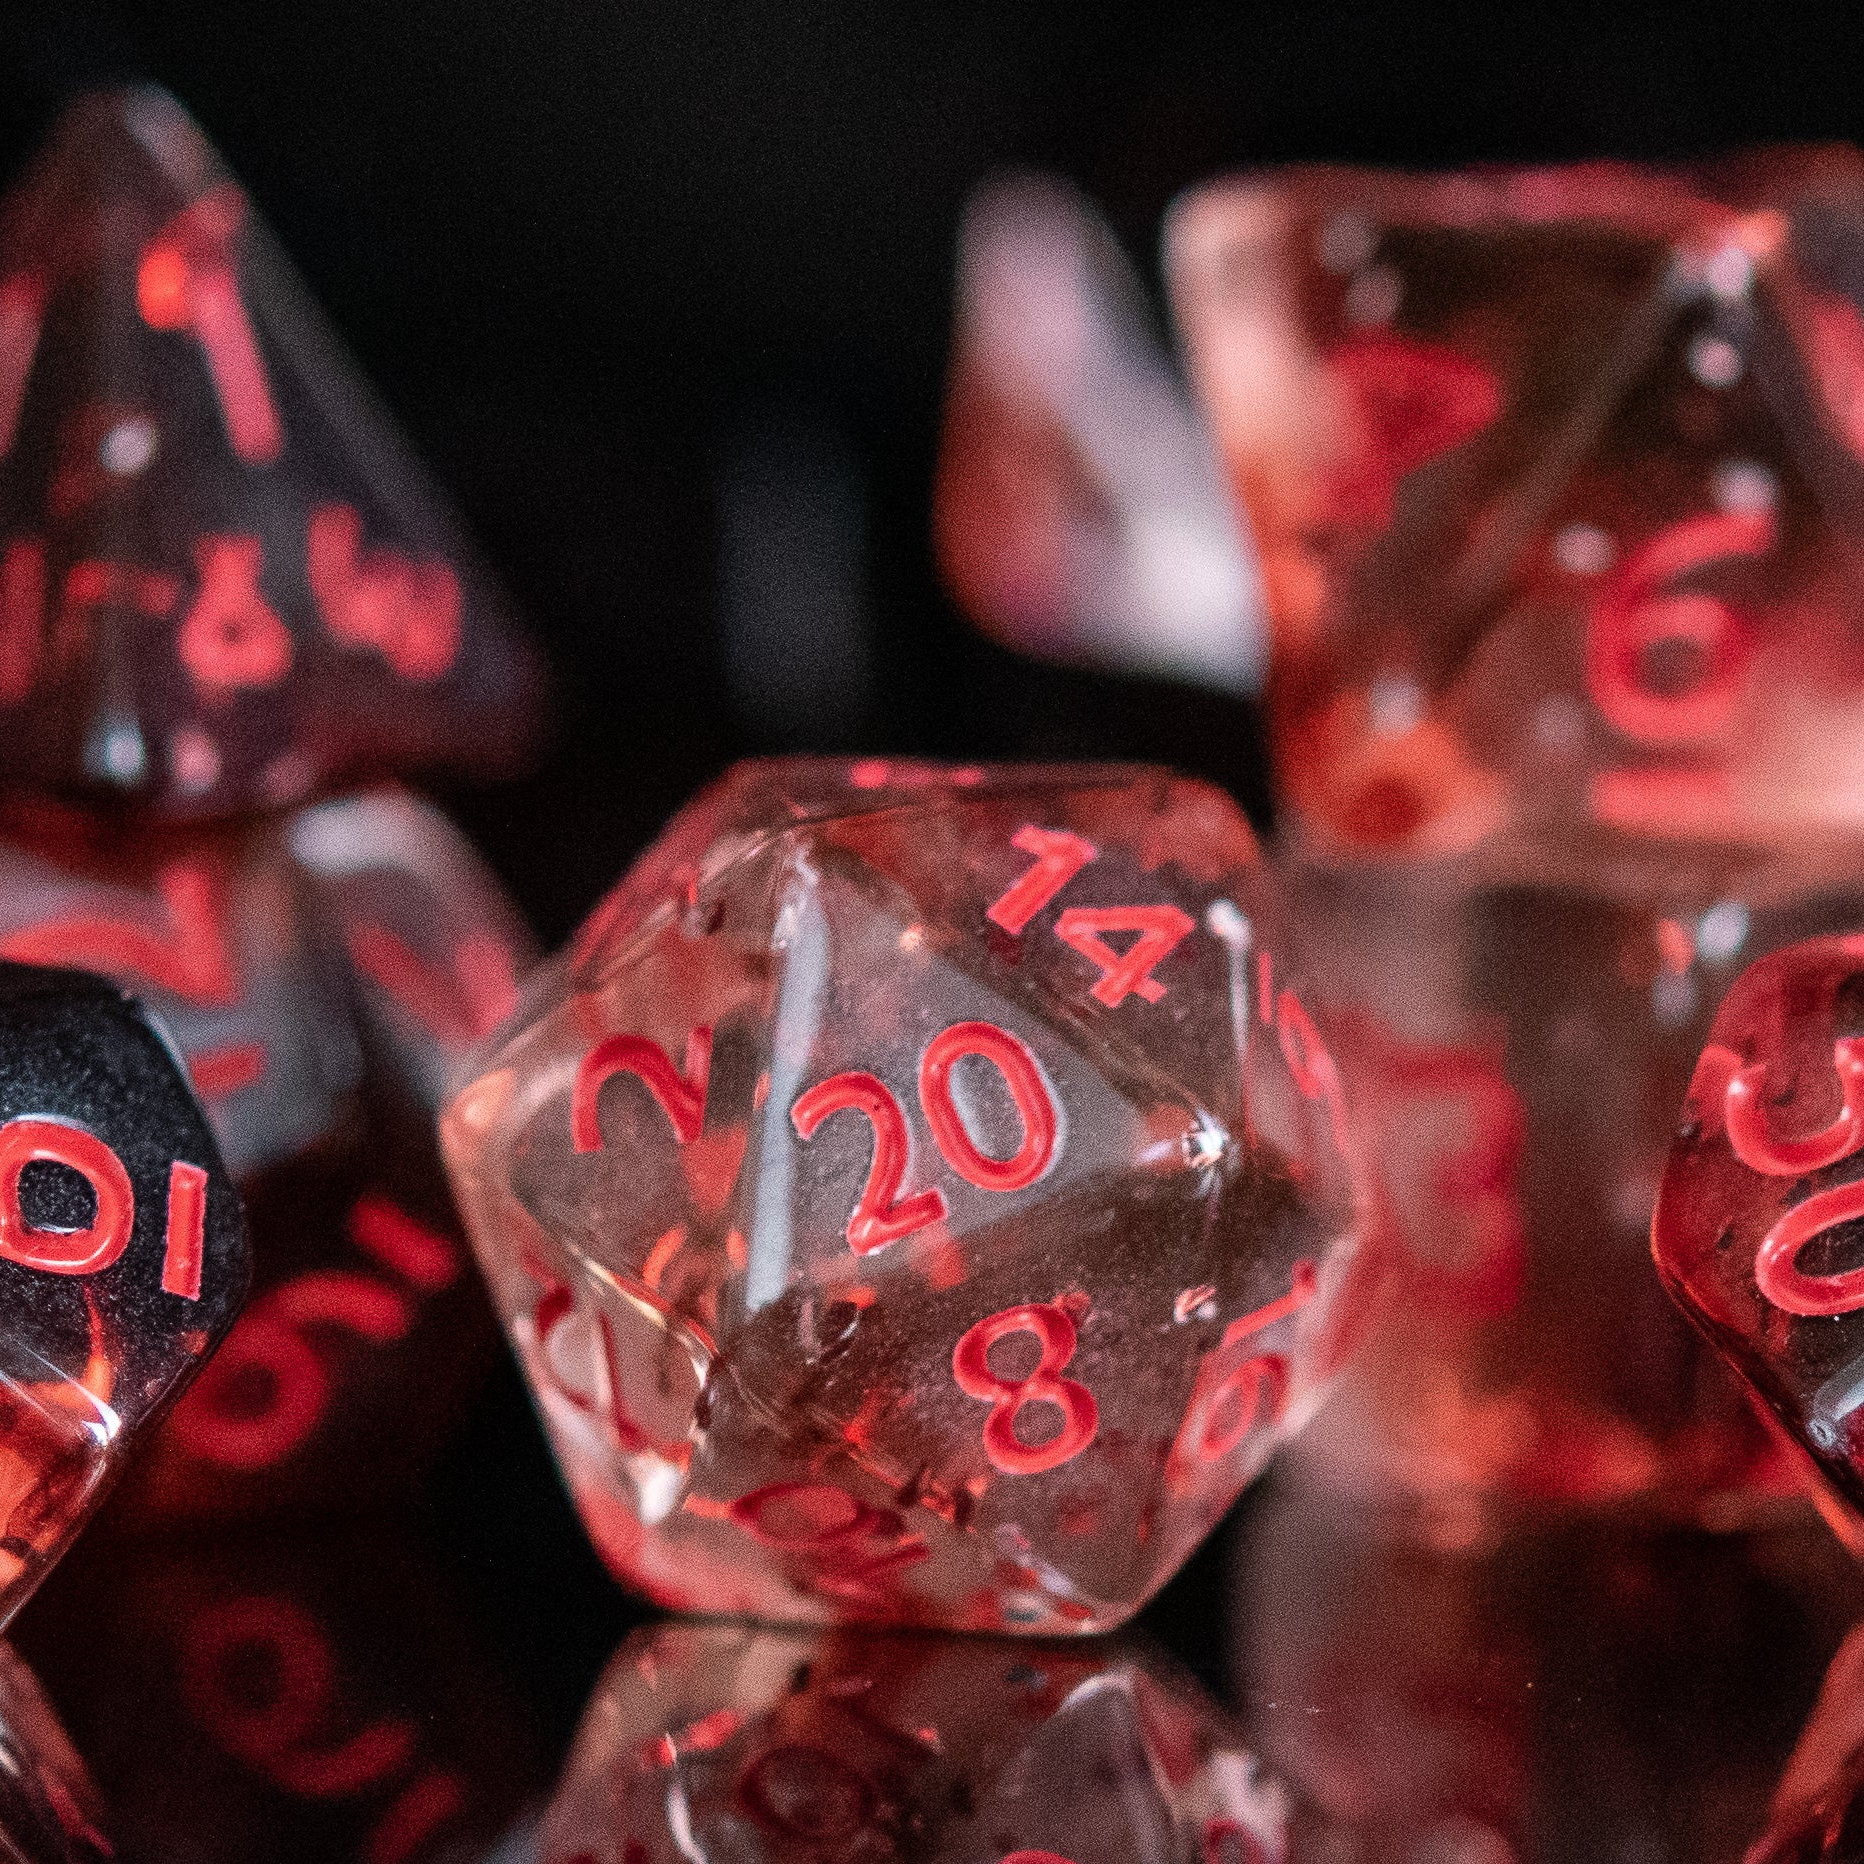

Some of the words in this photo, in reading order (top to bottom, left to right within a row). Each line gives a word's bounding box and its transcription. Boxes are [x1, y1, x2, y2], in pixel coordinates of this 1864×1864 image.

[987, 826, 1195, 1007] 14
[571, 1027, 714, 1153] 2
[792, 1021, 1055, 1257] 20
[953, 1303, 1098, 1475] 8
